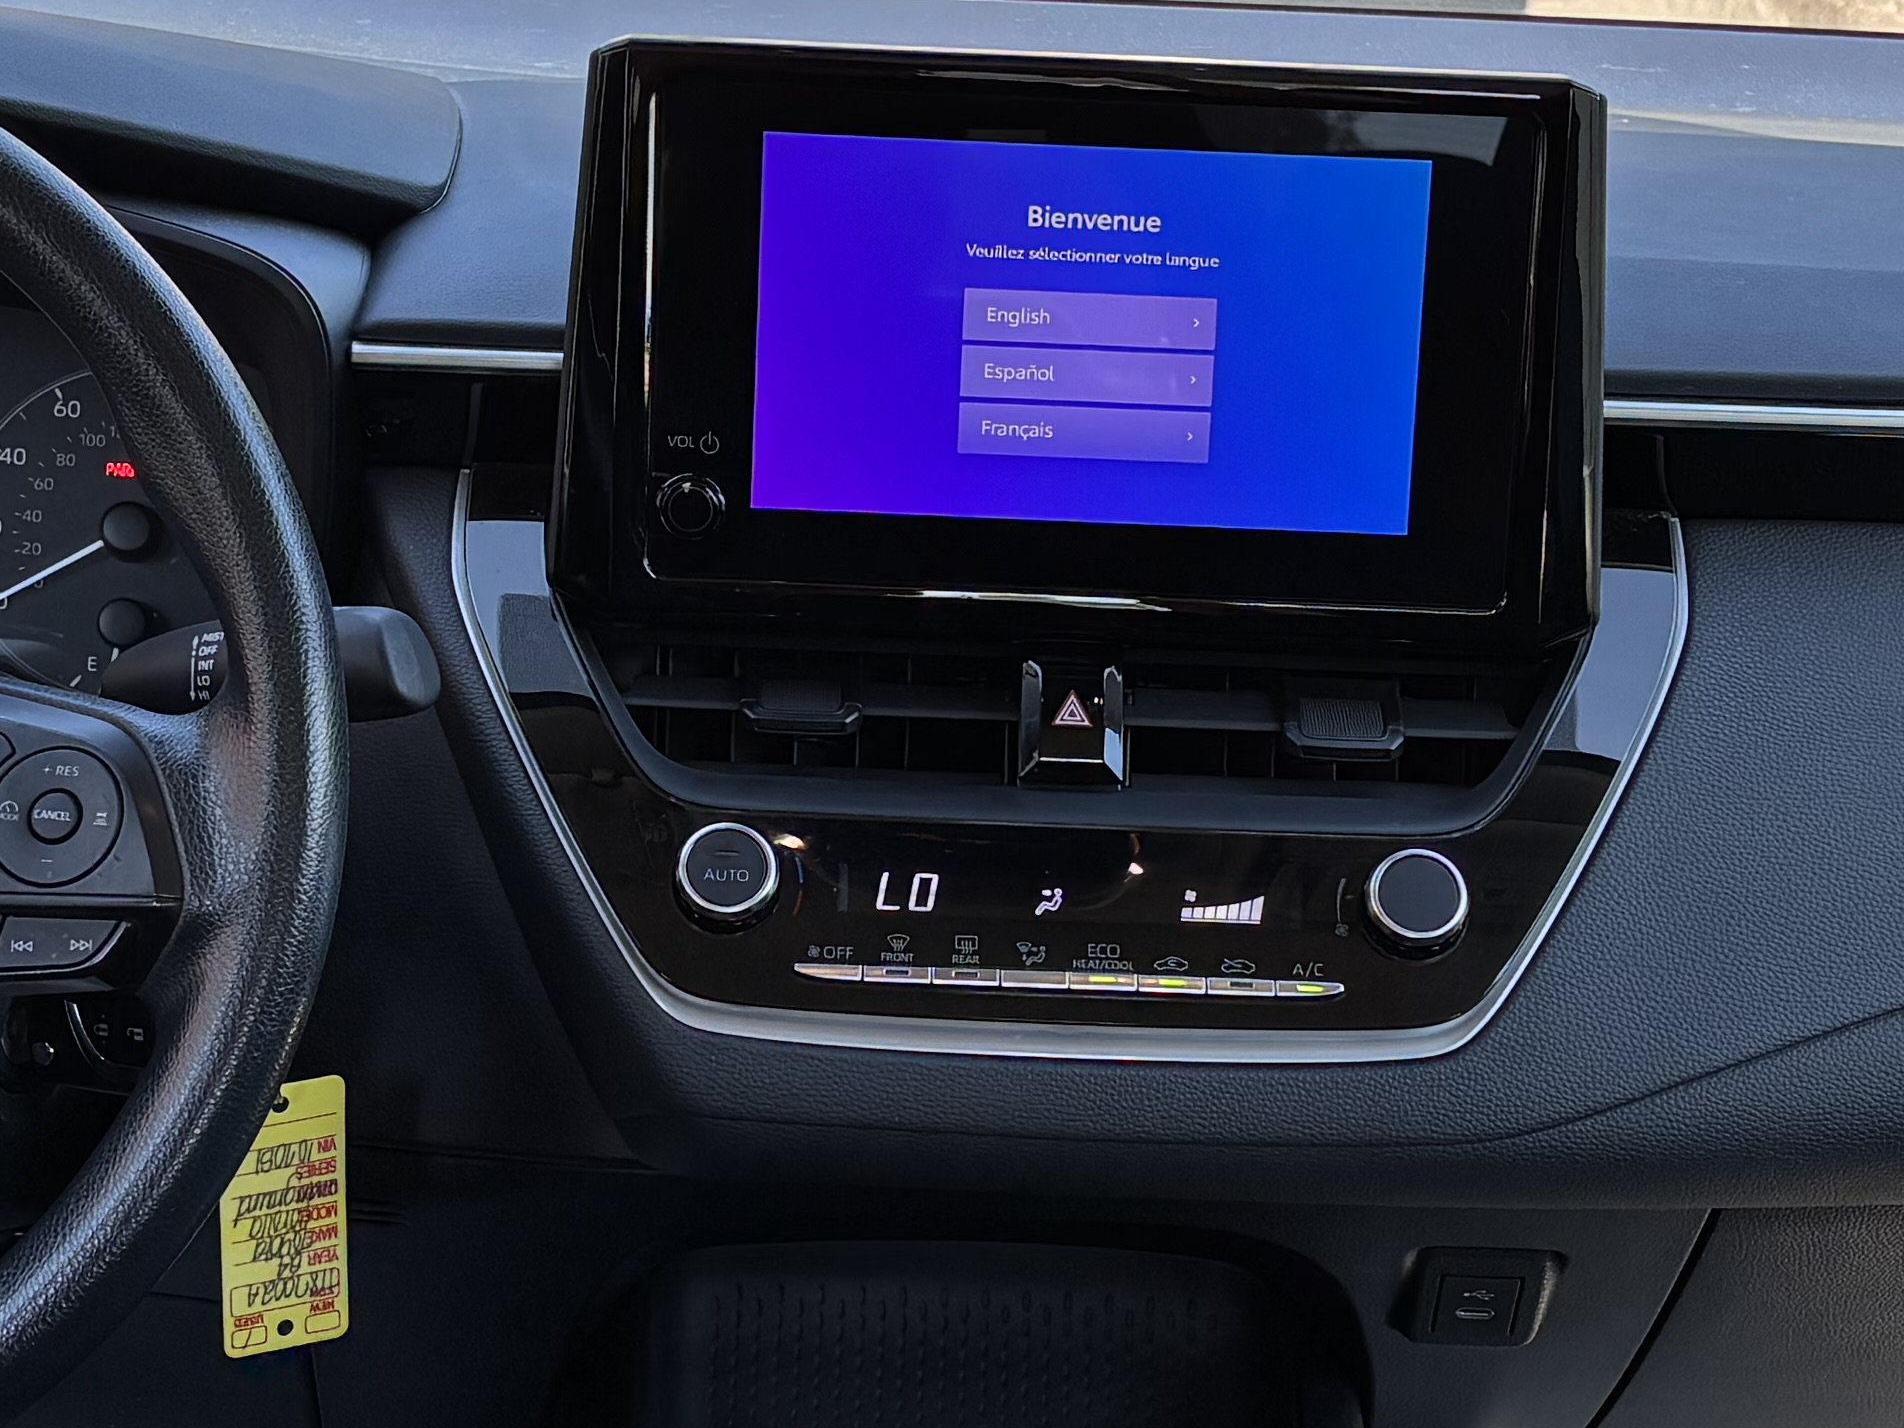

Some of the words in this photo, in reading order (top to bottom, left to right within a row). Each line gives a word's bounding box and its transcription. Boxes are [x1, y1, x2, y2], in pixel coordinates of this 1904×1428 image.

[1027, 205, 1162, 233] Bienvenue
[966, 243, 1025, 260] Veuillez
[1028, 247, 1121, 264] sélectionner
[1124, 252, 1162, 265] votre
[1166, 252, 1220, 270] langue
[986, 307, 1050, 327] English
[984, 363, 1054, 383] Español
[53, 400, 81, 418] 60
[981, 420, 1054, 440] Français
[79, 433, 106, 448] 100
[667, 435, 695, 448] VOL
[56, 454, 76, 467] 80
[34, 478, 54, 491] 60
[22, 510, 42, 522] 40
[21, 542, 42, 555] 20
[198, 645, 218, 657] OFF
[87, 656, 97, 672] E
[33, 809, 72, 822] CANCEL
[703, 867, 750, 882] AUTO
[876, 871, 939, 912] LO
[823, 945, 855, 960] OFF
[880, 951, 914, 963] FRONT
[952, 953, 980, 964] REAR
[1087, 943, 1120, 959] ECO
[1072, 958, 1134, 970] HEAT/COOL
[1292, 962, 1324, 977] A/C
[317, 1138, 337, 1153] VIN
[303, 1225, 338, 1244] MAKE
[307, 1248, 339, 1266] YEAR
[309, 1300, 335, 1314] NEW
[233, 1314, 264, 1328] USED
